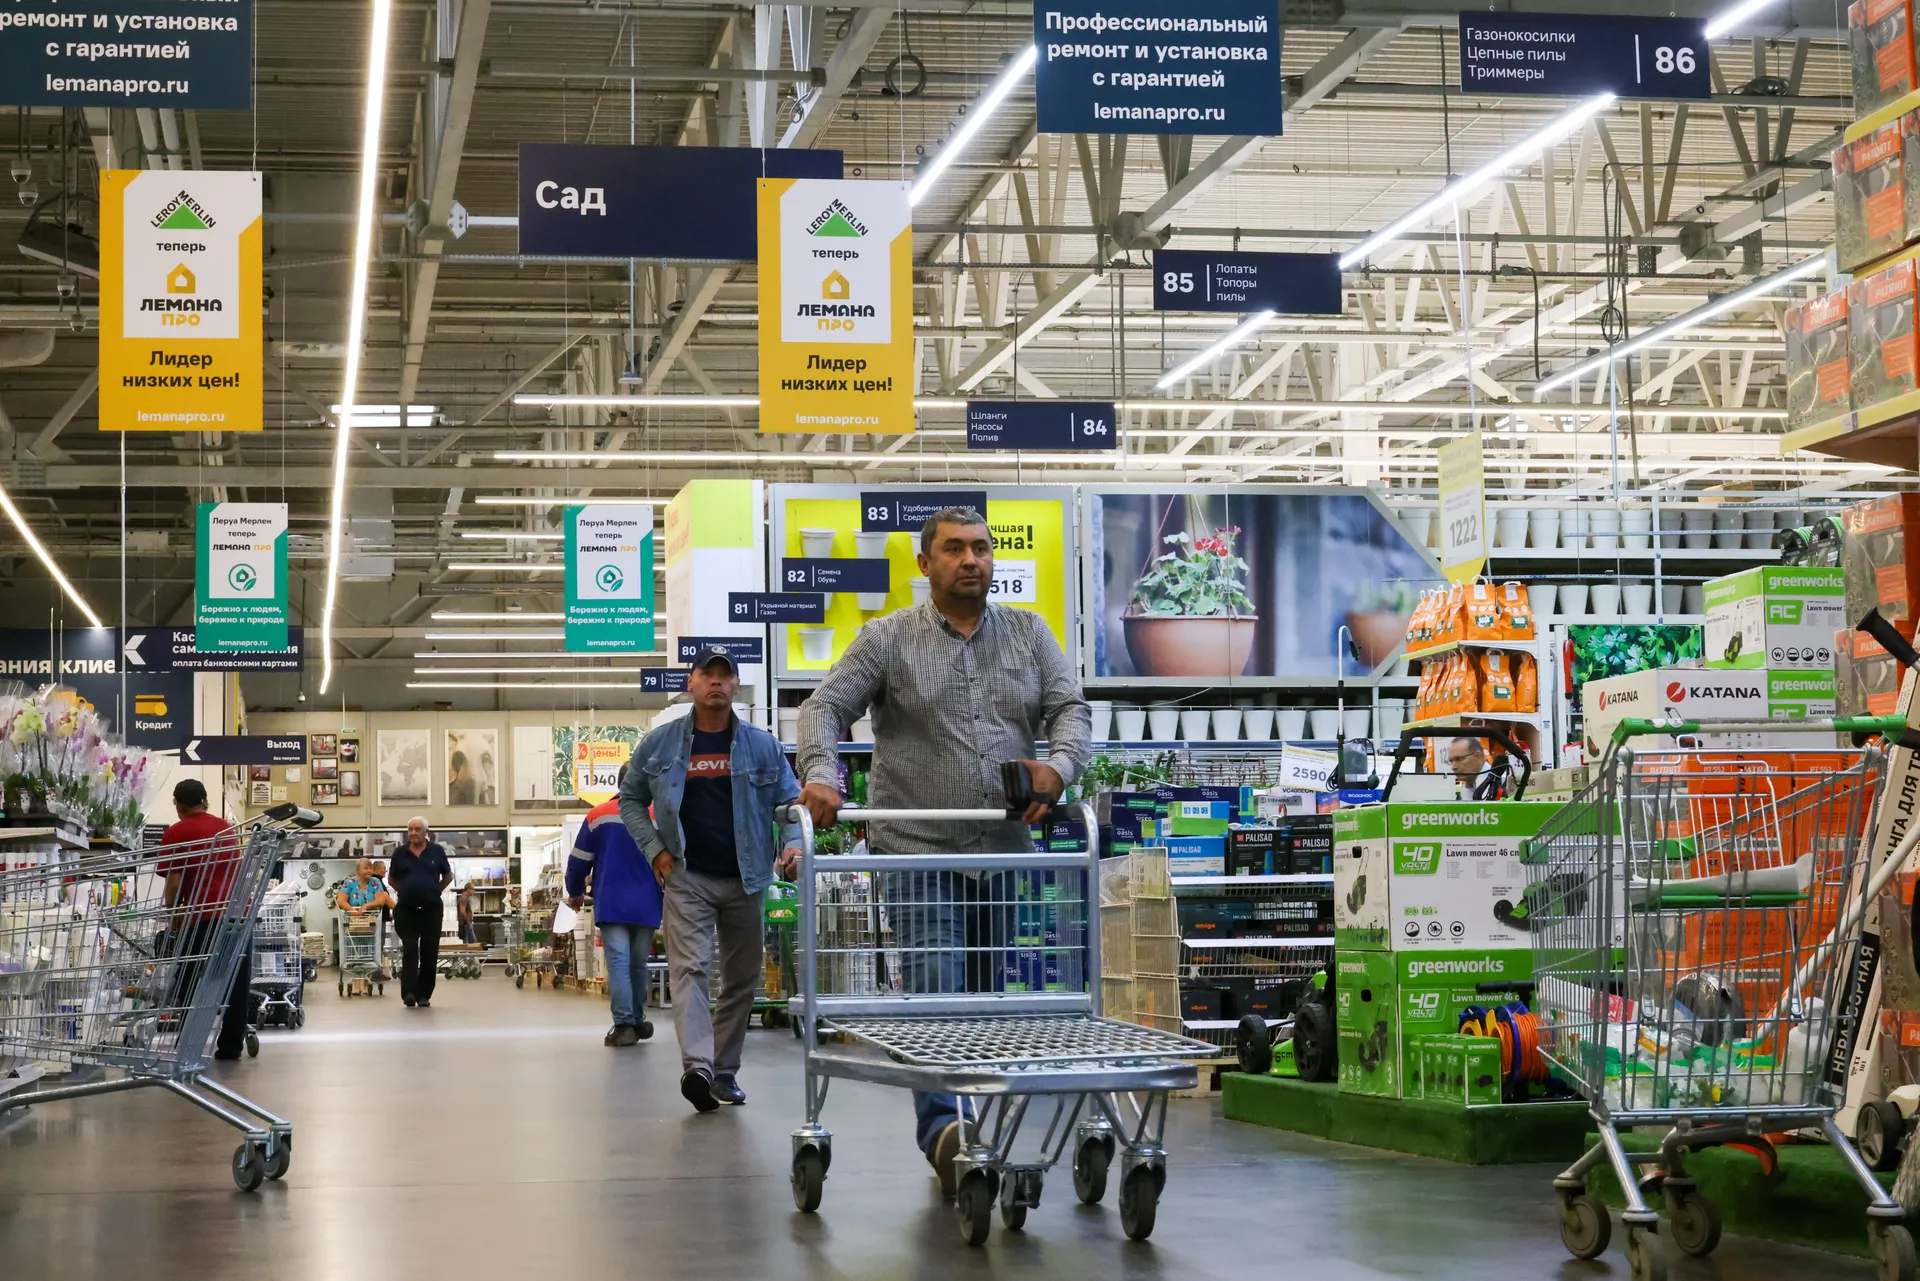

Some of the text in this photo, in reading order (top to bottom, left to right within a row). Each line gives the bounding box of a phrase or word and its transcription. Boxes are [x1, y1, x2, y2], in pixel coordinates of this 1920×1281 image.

[0, 12, 238, 33] ремонт и установка
[1045, 12, 1268, 34] Профессиональный
[1466, 27, 1576, 44] Газонокосилки
[46, 40, 189, 61] с гарантией
[1047, 43, 1268, 63] ремонт и установка
[1467, 46, 1566, 62] Цепные пилы
[1655, 46, 1696, 74] 86
[1092, 69, 1225, 90] с гарантией
[1468, 65, 1545, 81] Триммеры
[46, 74, 188, 96] lemanapro.ru
[1094, 102, 1225, 124] lemanapro.ru
[535, 180, 606, 216] Сад
[150, 190, 216, 229] LEROY MERLIN
[805, 198, 869, 237] LEROY MERLIN
[156, 242, 206, 254] теперь
[811, 249, 860, 261] теперь
[1216, 264, 1257, 275] Лопаты
[1163, 272, 1194, 293] 85
[1216, 277, 1257, 289] Топоры
[1216, 293, 1246, 302] пилы
[140, 299, 222, 312] ЛЕМАНА
[796, 304, 875, 318] ЛЕМАНА
[161, 314, 200, 326] ПРО
[817, 318, 855, 332] ПРО
[149, 351, 213, 369] Лидер
[806, 354, 867, 374] Лидер
[122, 373, 240, 389] низких цен!
[781, 376, 893, 394] низких цен!
[137, 411, 225, 425] lemanapro.ru
[795, 412, 879, 427] lemanapro.ru
[971, 412, 1007, 421] Шланги
[971, 423, 1003, 431] Насосы
[1083, 419, 1107, 436] 84
[971, 434, 999, 442] Полив
[867, 507, 889, 521] 83
[902, 504, 943, 513] Удобрения
[212, 517, 272, 526] Леруа Мерлен
[579, 519, 638, 527] Леруа Мерлен
[991, 525, 1024, 533] чшая
[1450, 515, 1477, 548] 1222
[594, 532, 623, 540] теперь
[992, 525, 1034, 549] ена!
[787, 570, 806, 583] 82
[817, 568, 841, 576] Семена
[817, 576, 836, 584] Обувь
[1769, 574, 1844, 589] greenworks
[990, 580, 1023, 594] 518
[201, 605, 241, 614] Бережно
[250, 606, 282, 614] людям,
[570, 606, 608, 615] Бережно
[617, 606, 648, 614] людям,
[734, 603, 748, 614] 81
[760, 602, 788, 610] Укрывной
[1770, 605, 1796, 618] AC
[199, 616, 238, 624] бережно
[246, 617, 285, 625] природе
[567, 616, 606, 625] бережно
[173, 632, 195, 642] Кас
[218, 639, 268, 647] lemanapro.ru
[586, 639, 635, 647] lemanapro.ru
[681, 646, 696, 656] 80
[172, 658, 298, 669] оплата банковскими картами
[644, 677, 657, 685] 79
[1607, 690, 1638, 705] KATANA
[1690, 687, 1761, 698] KATANA
[135, 721, 172, 731] Кредит
[267, 740, 301, 751] Выход
[584, 774, 616, 786] 1940
[1293, 767, 1327, 781] 2590
[1898, 775, 1919, 815] ДЛЯ
[1402, 809, 1499, 829] greenworks
[1245, 833, 1273, 842] PALISAD
[1302, 839, 1330, 847] PALISAD
[1402, 846, 1434, 862] 40
[1446, 849, 1468, 857] Lawn
[1499, 848, 1508, 856] 46
[1283, 923, 1309, 932] PALISAD
[1408, 956, 1504, 978] greenworks
[1409, 993, 1439, 1008] 40
[1452, 993, 1513, 1002] Lawn mower 46
[1468, 1043, 1498, 1051] greenworks
